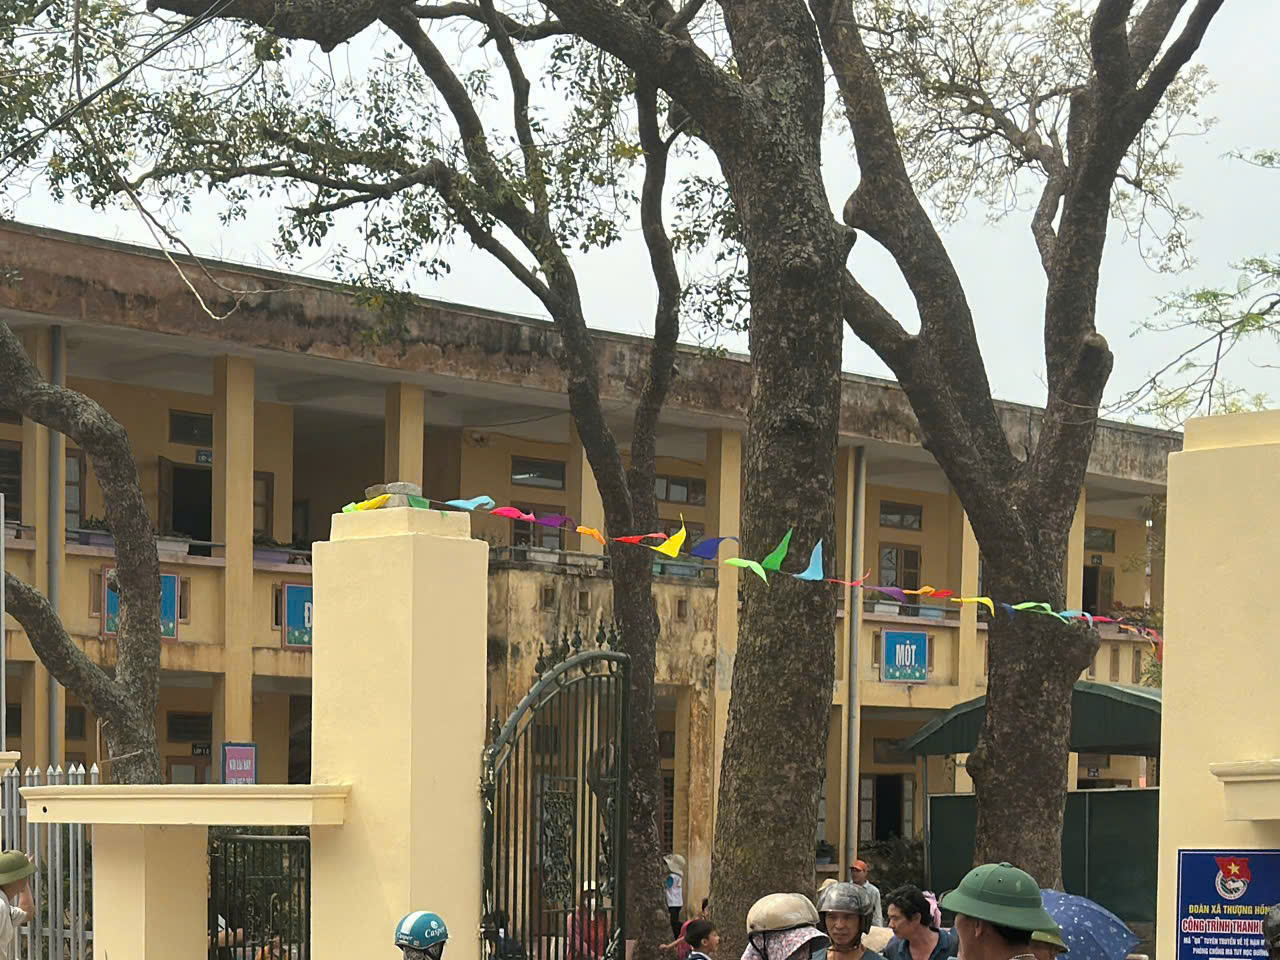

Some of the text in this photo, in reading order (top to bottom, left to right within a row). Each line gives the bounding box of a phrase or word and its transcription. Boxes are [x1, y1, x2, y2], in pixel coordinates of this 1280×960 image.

[1189, 903, 1209, 914] ĐOÀN
[1182, 915, 1205, 932] CÔNG
[1206, 916, 1231, 932] TRÌNH
[1232, 919, 1259, 933] THANH
